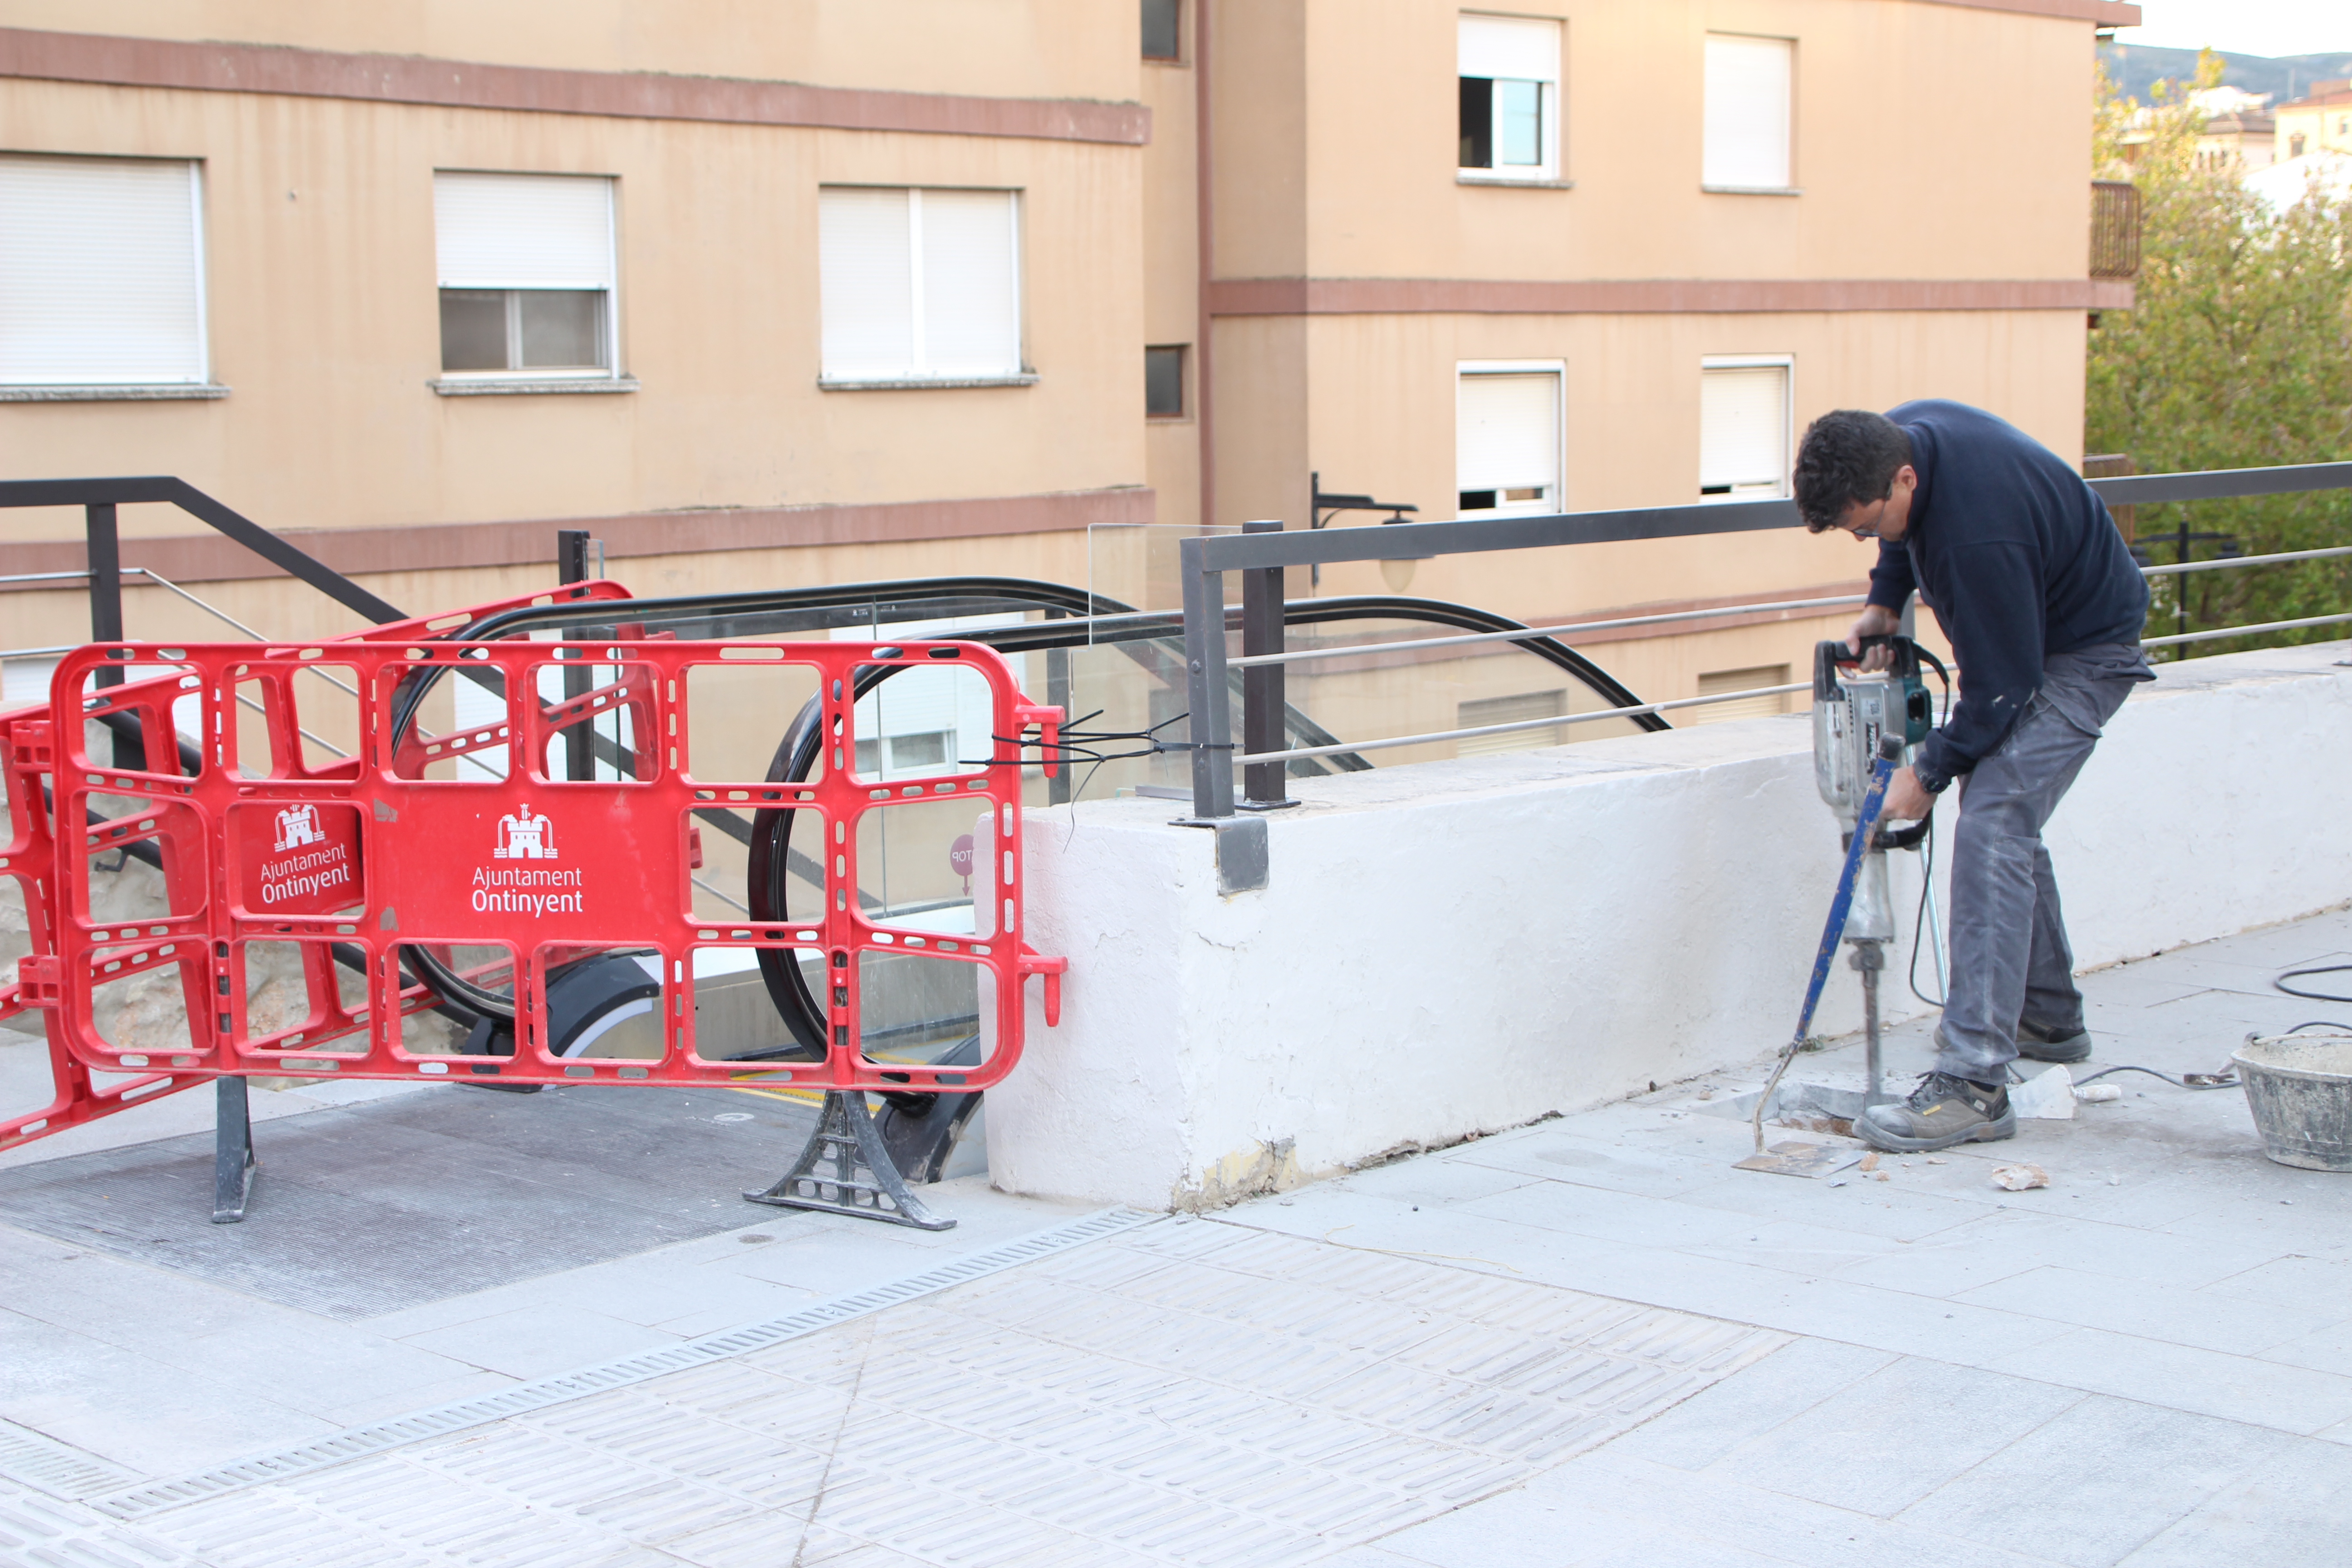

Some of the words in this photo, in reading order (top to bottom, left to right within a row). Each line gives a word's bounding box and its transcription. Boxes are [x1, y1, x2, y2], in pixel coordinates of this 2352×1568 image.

[261, 843, 347, 883] Ajuntament
[472, 866, 582, 890] Ajuntament
[262, 862, 350, 904] Ontinyent
[472, 888, 583, 918] Ontinyent
